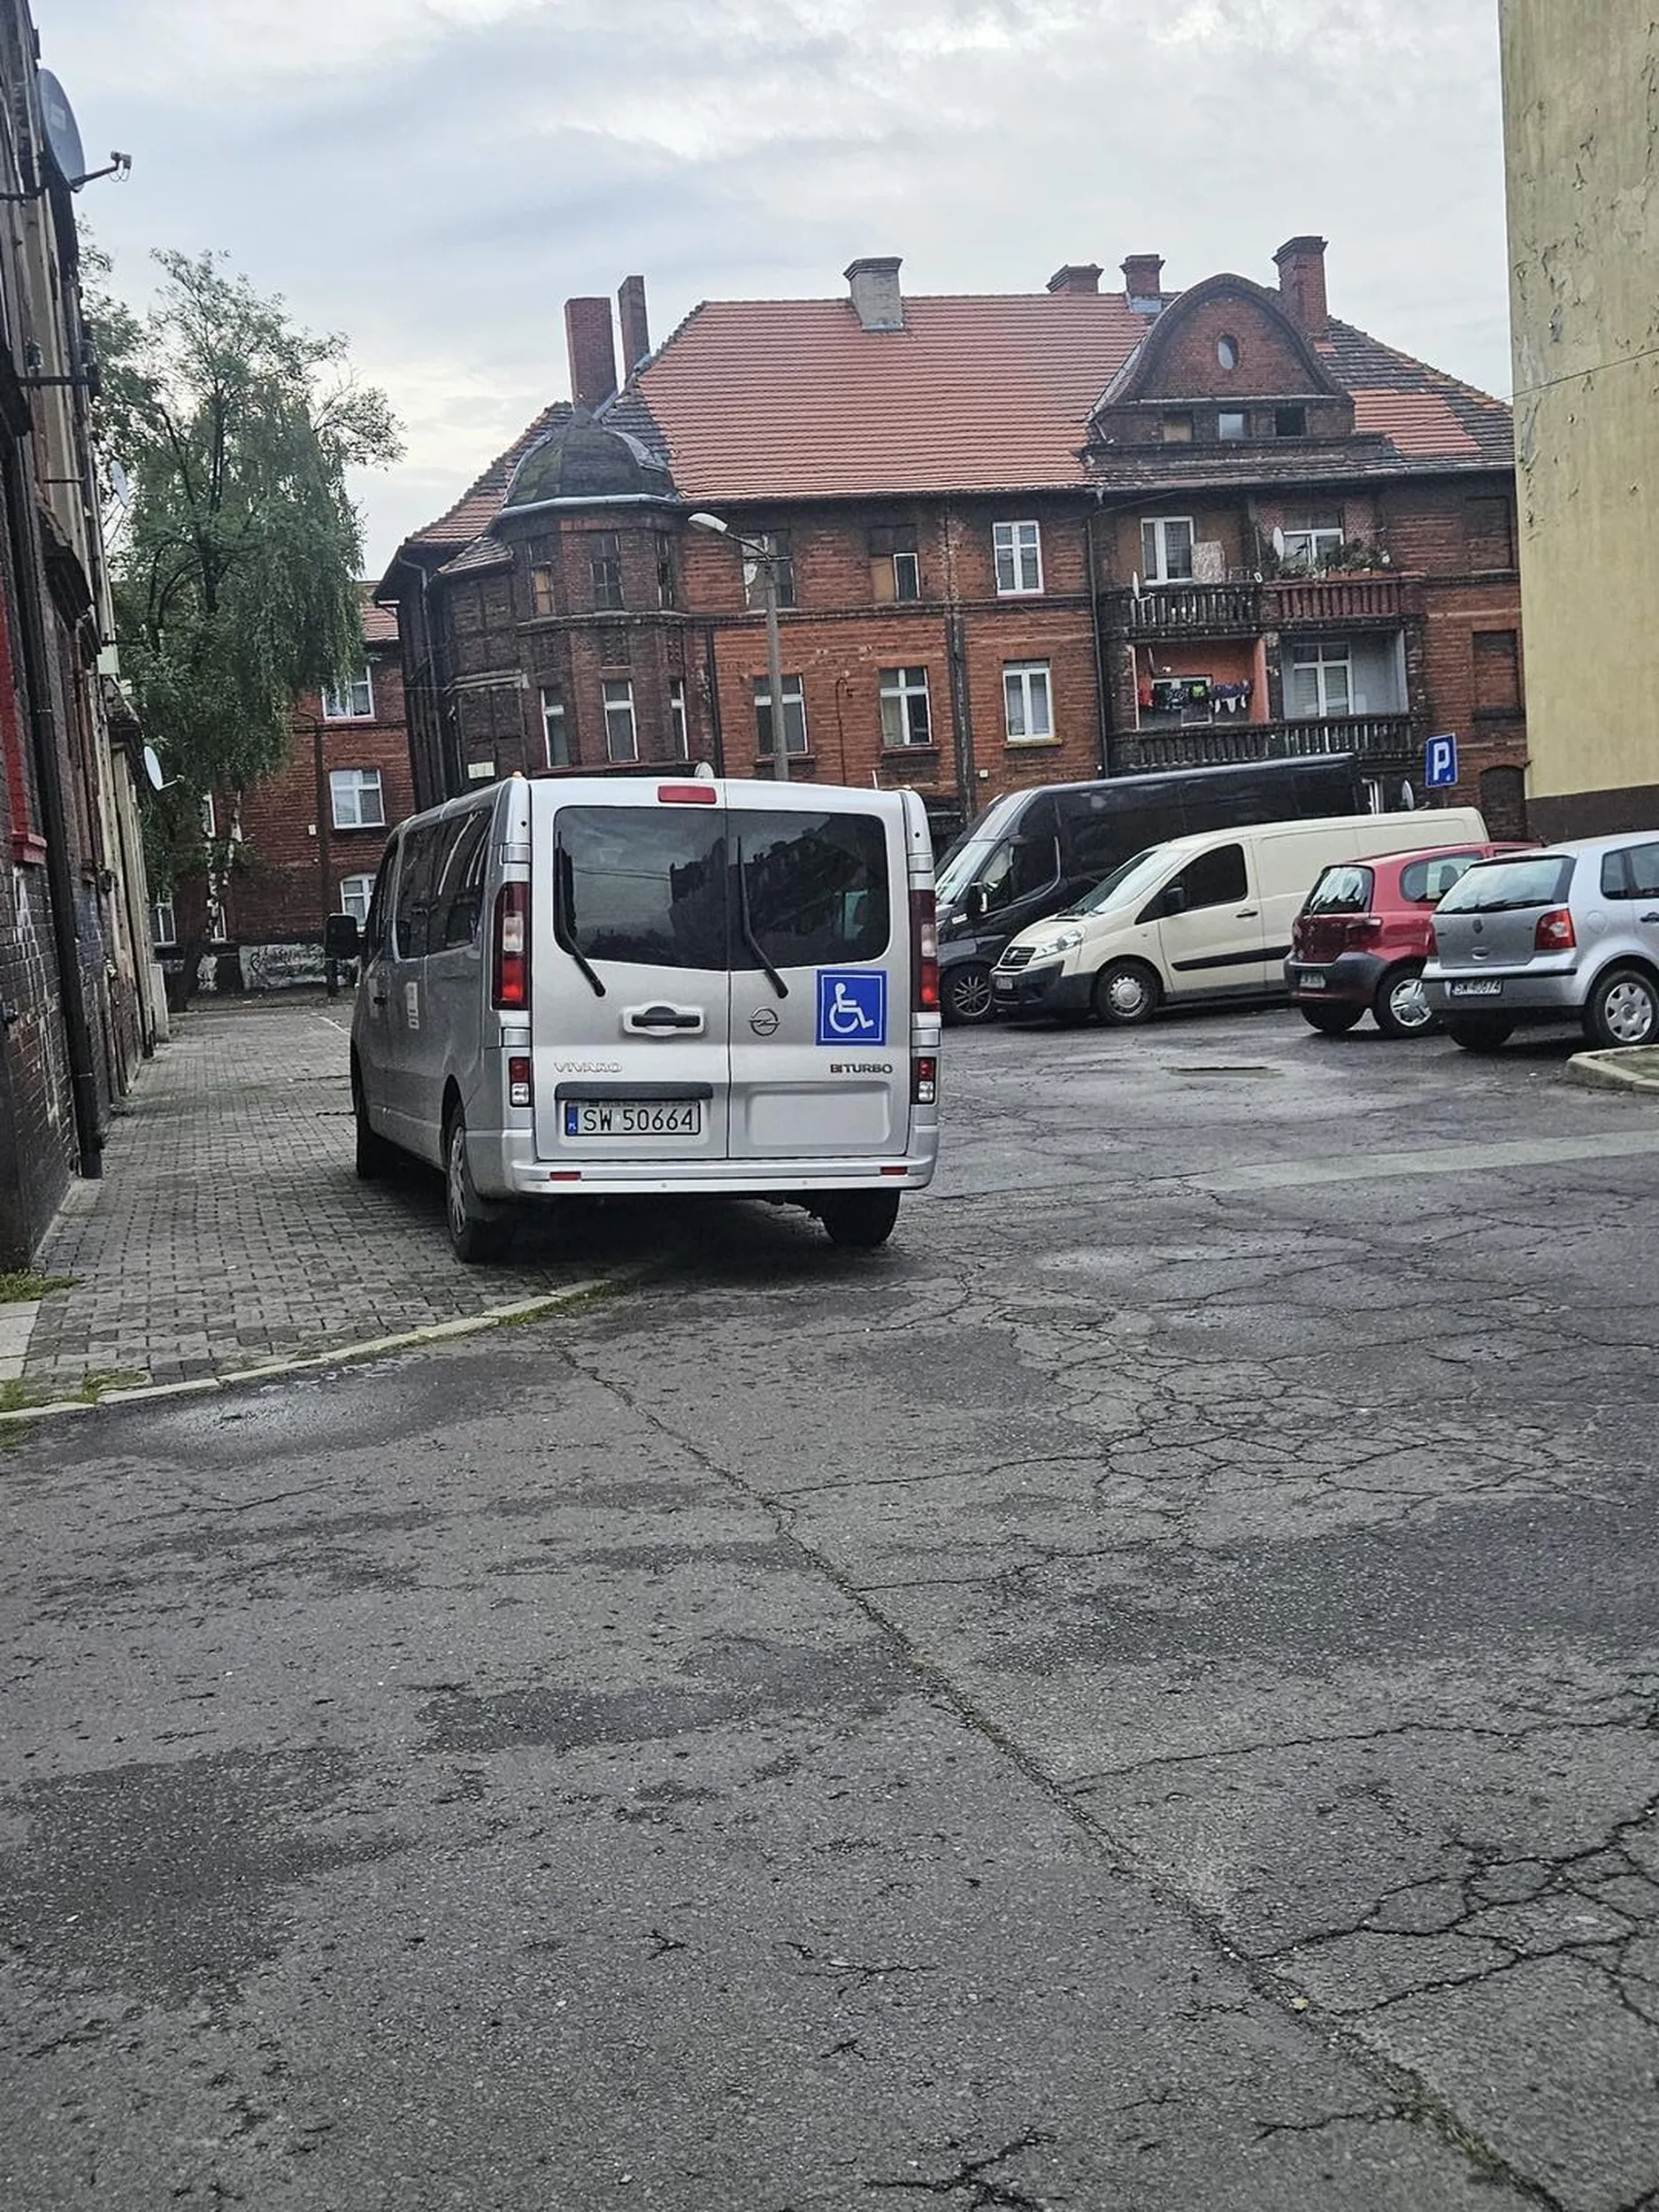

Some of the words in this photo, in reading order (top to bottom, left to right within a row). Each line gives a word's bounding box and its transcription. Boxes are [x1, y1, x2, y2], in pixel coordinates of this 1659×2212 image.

[1433, 741, 1450, 780] P
[554, 1062, 623, 1073] VIVARO
[583, 1109, 612, 1132] SW
[623, 1108, 693, 1132] 50664
